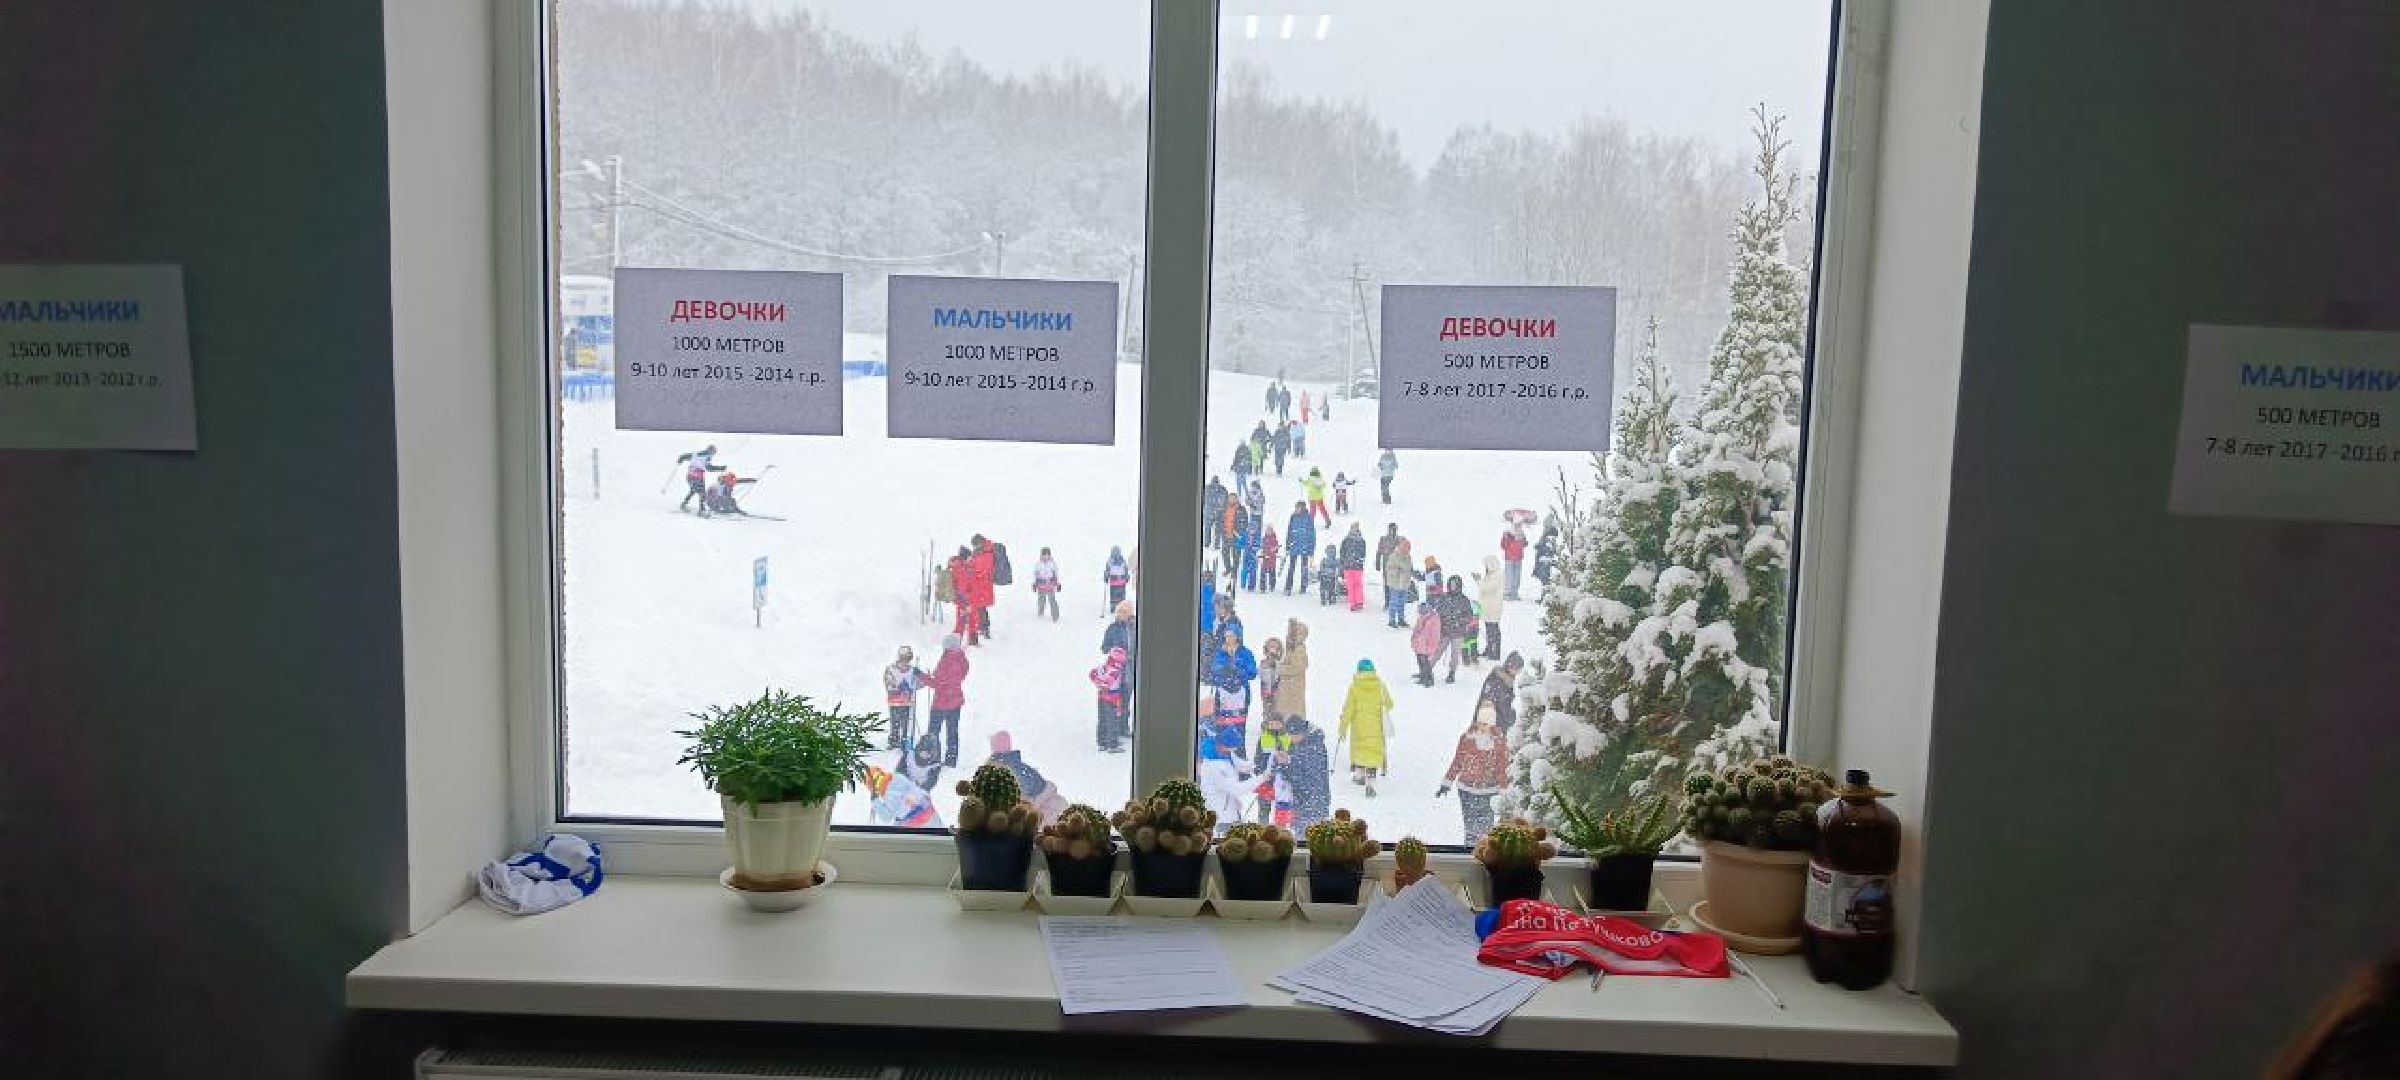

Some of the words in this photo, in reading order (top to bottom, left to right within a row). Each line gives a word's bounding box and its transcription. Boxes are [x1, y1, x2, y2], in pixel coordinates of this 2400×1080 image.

[670, 300, 785, 323] ДЕВОЧКИ
[933, 308, 1073, 331] МАЛЬЧИКИ
[1439, 317, 1556, 341] ДЕВОЧКИ
[9, 342, 50, 358] 1500
[57, 343, 131, 358] МЕТРОВ
[673, 336, 711, 351] 1000
[715, 338, 784, 353] МЕТРОВ
[945, 344, 985, 360] 1000
[990, 345, 1060, 362] МЕТРОВ
[1444, 354, 1474, 369] 500
[1480, 355, 1549, 370] МЕТРОВ
[26, 375, 48, 386] лет
[631, 362, 668, 378] 9-10
[672, 367, 700, 379] лет
[704, 364, 743, 381] 2015
[748, 366, 794, 382] -2014
[799, 372, 826, 386] г.р.
[904, 370, 942, 386] 9-10
[944, 374, 972, 387] лет
[977, 374, 1017, 389] 2015
[1020, 375, 1067, 391] -2014
[1071, 379, 1097, 393] г.р.
[1403, 382, 1429, 397] 7-8
[1434, 385, 1462, 397] лет
[1467, 383, 1506, 398] 2017
[1510, 384, 1557, 399] -2016
[1562, 389, 1590, 402] г.р.
[2257, 407, 2292, 424] 500
[2298, 410, 2380, 428] МЕТРОВ
[2240, 444, 2276, 459] лет
[2280, 442, 2327, 459] 2017
